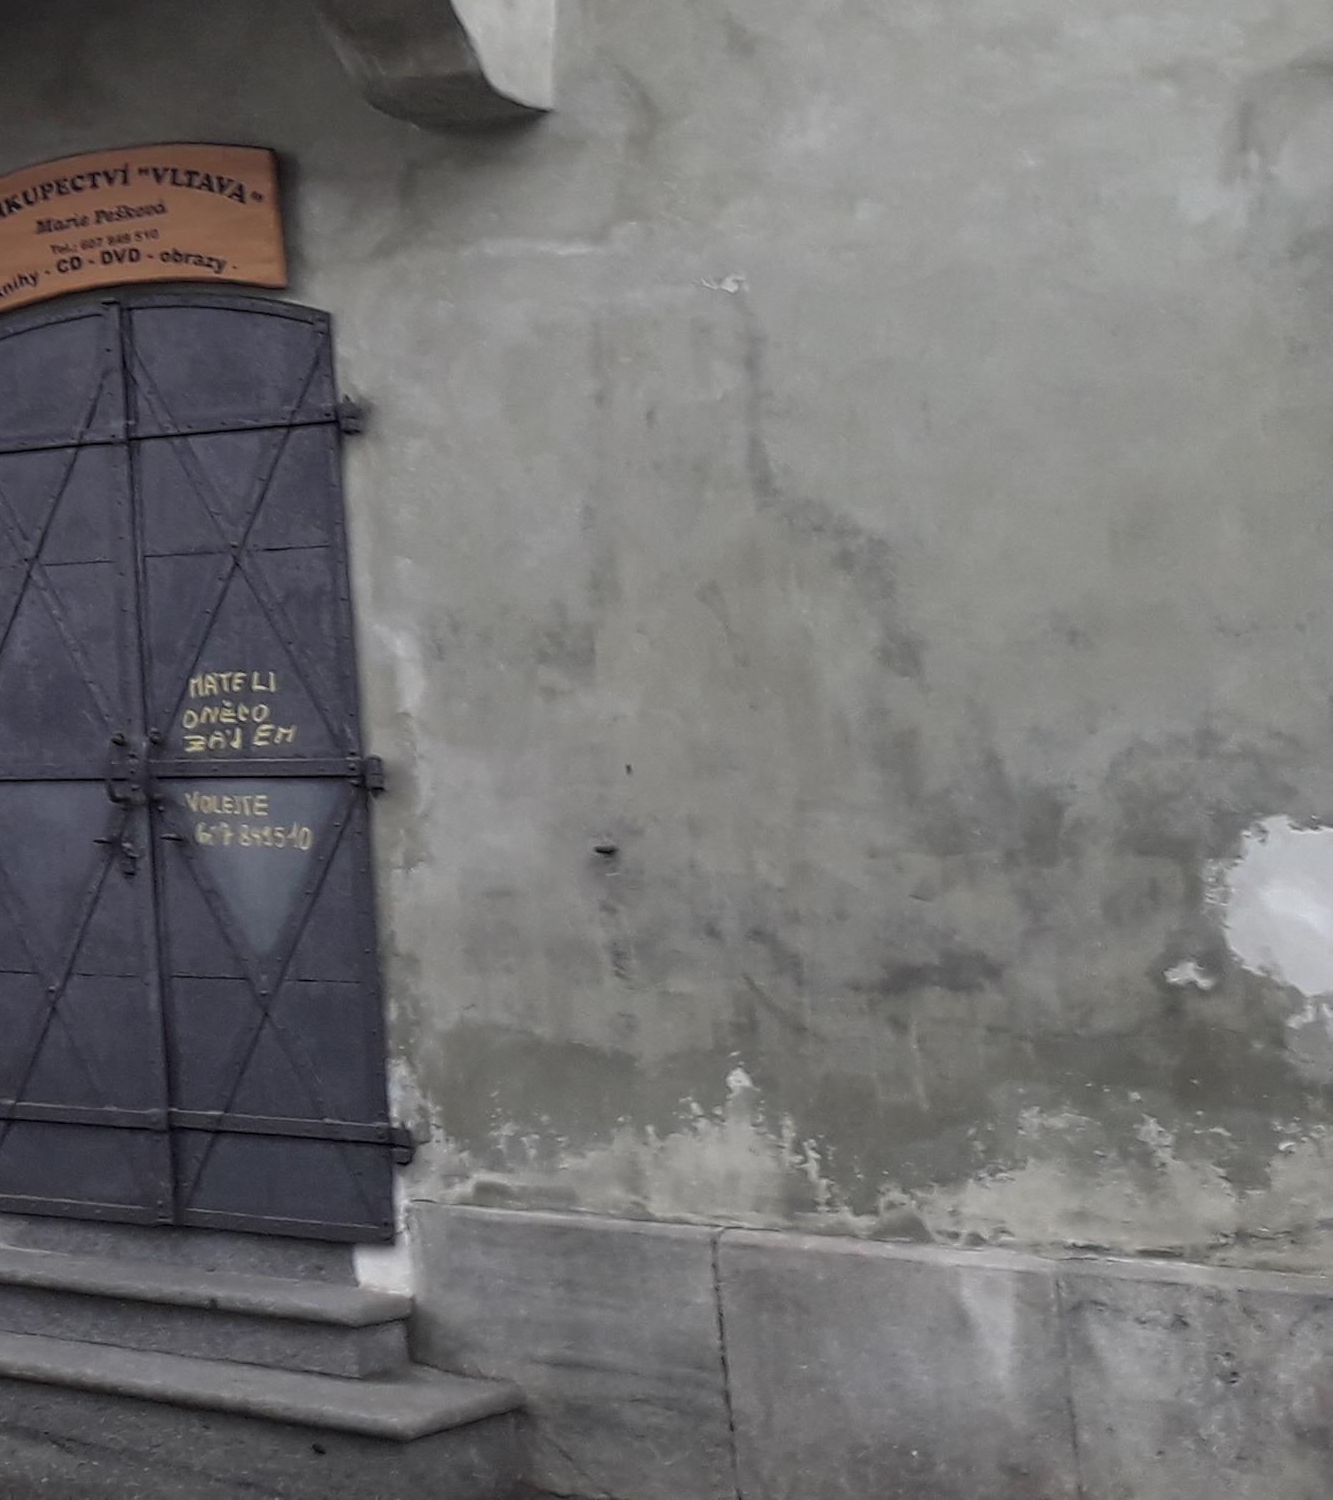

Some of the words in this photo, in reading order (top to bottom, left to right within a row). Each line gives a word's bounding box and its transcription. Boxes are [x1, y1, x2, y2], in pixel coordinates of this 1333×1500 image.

[35, 213, 90, 235] Marie
[56, 256, 83, 274] CD
[101, 249, 141, 265] DVD
[159, 249, 227, 274] obrazy
